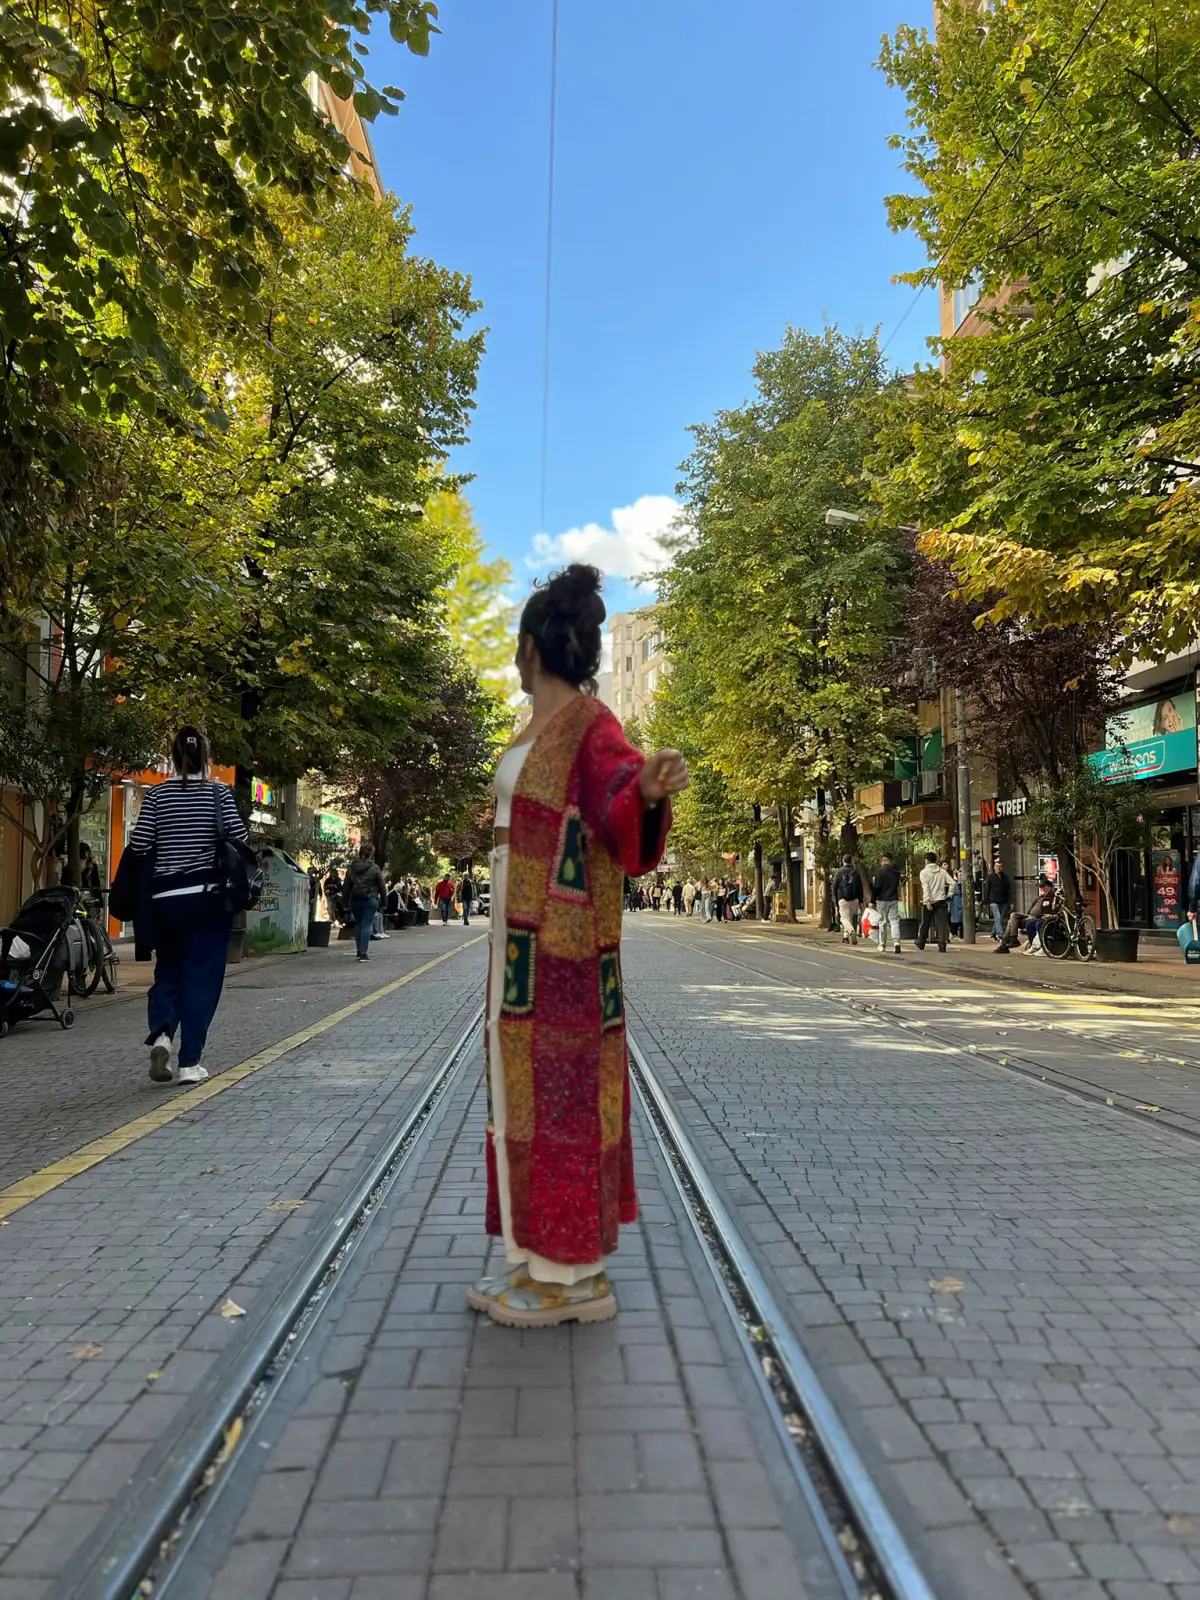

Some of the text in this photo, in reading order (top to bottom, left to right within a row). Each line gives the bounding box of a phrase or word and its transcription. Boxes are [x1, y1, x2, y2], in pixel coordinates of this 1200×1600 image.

[1109, 750, 1156, 772] wasons
[982, 797, 1027, 823] IN STREET
